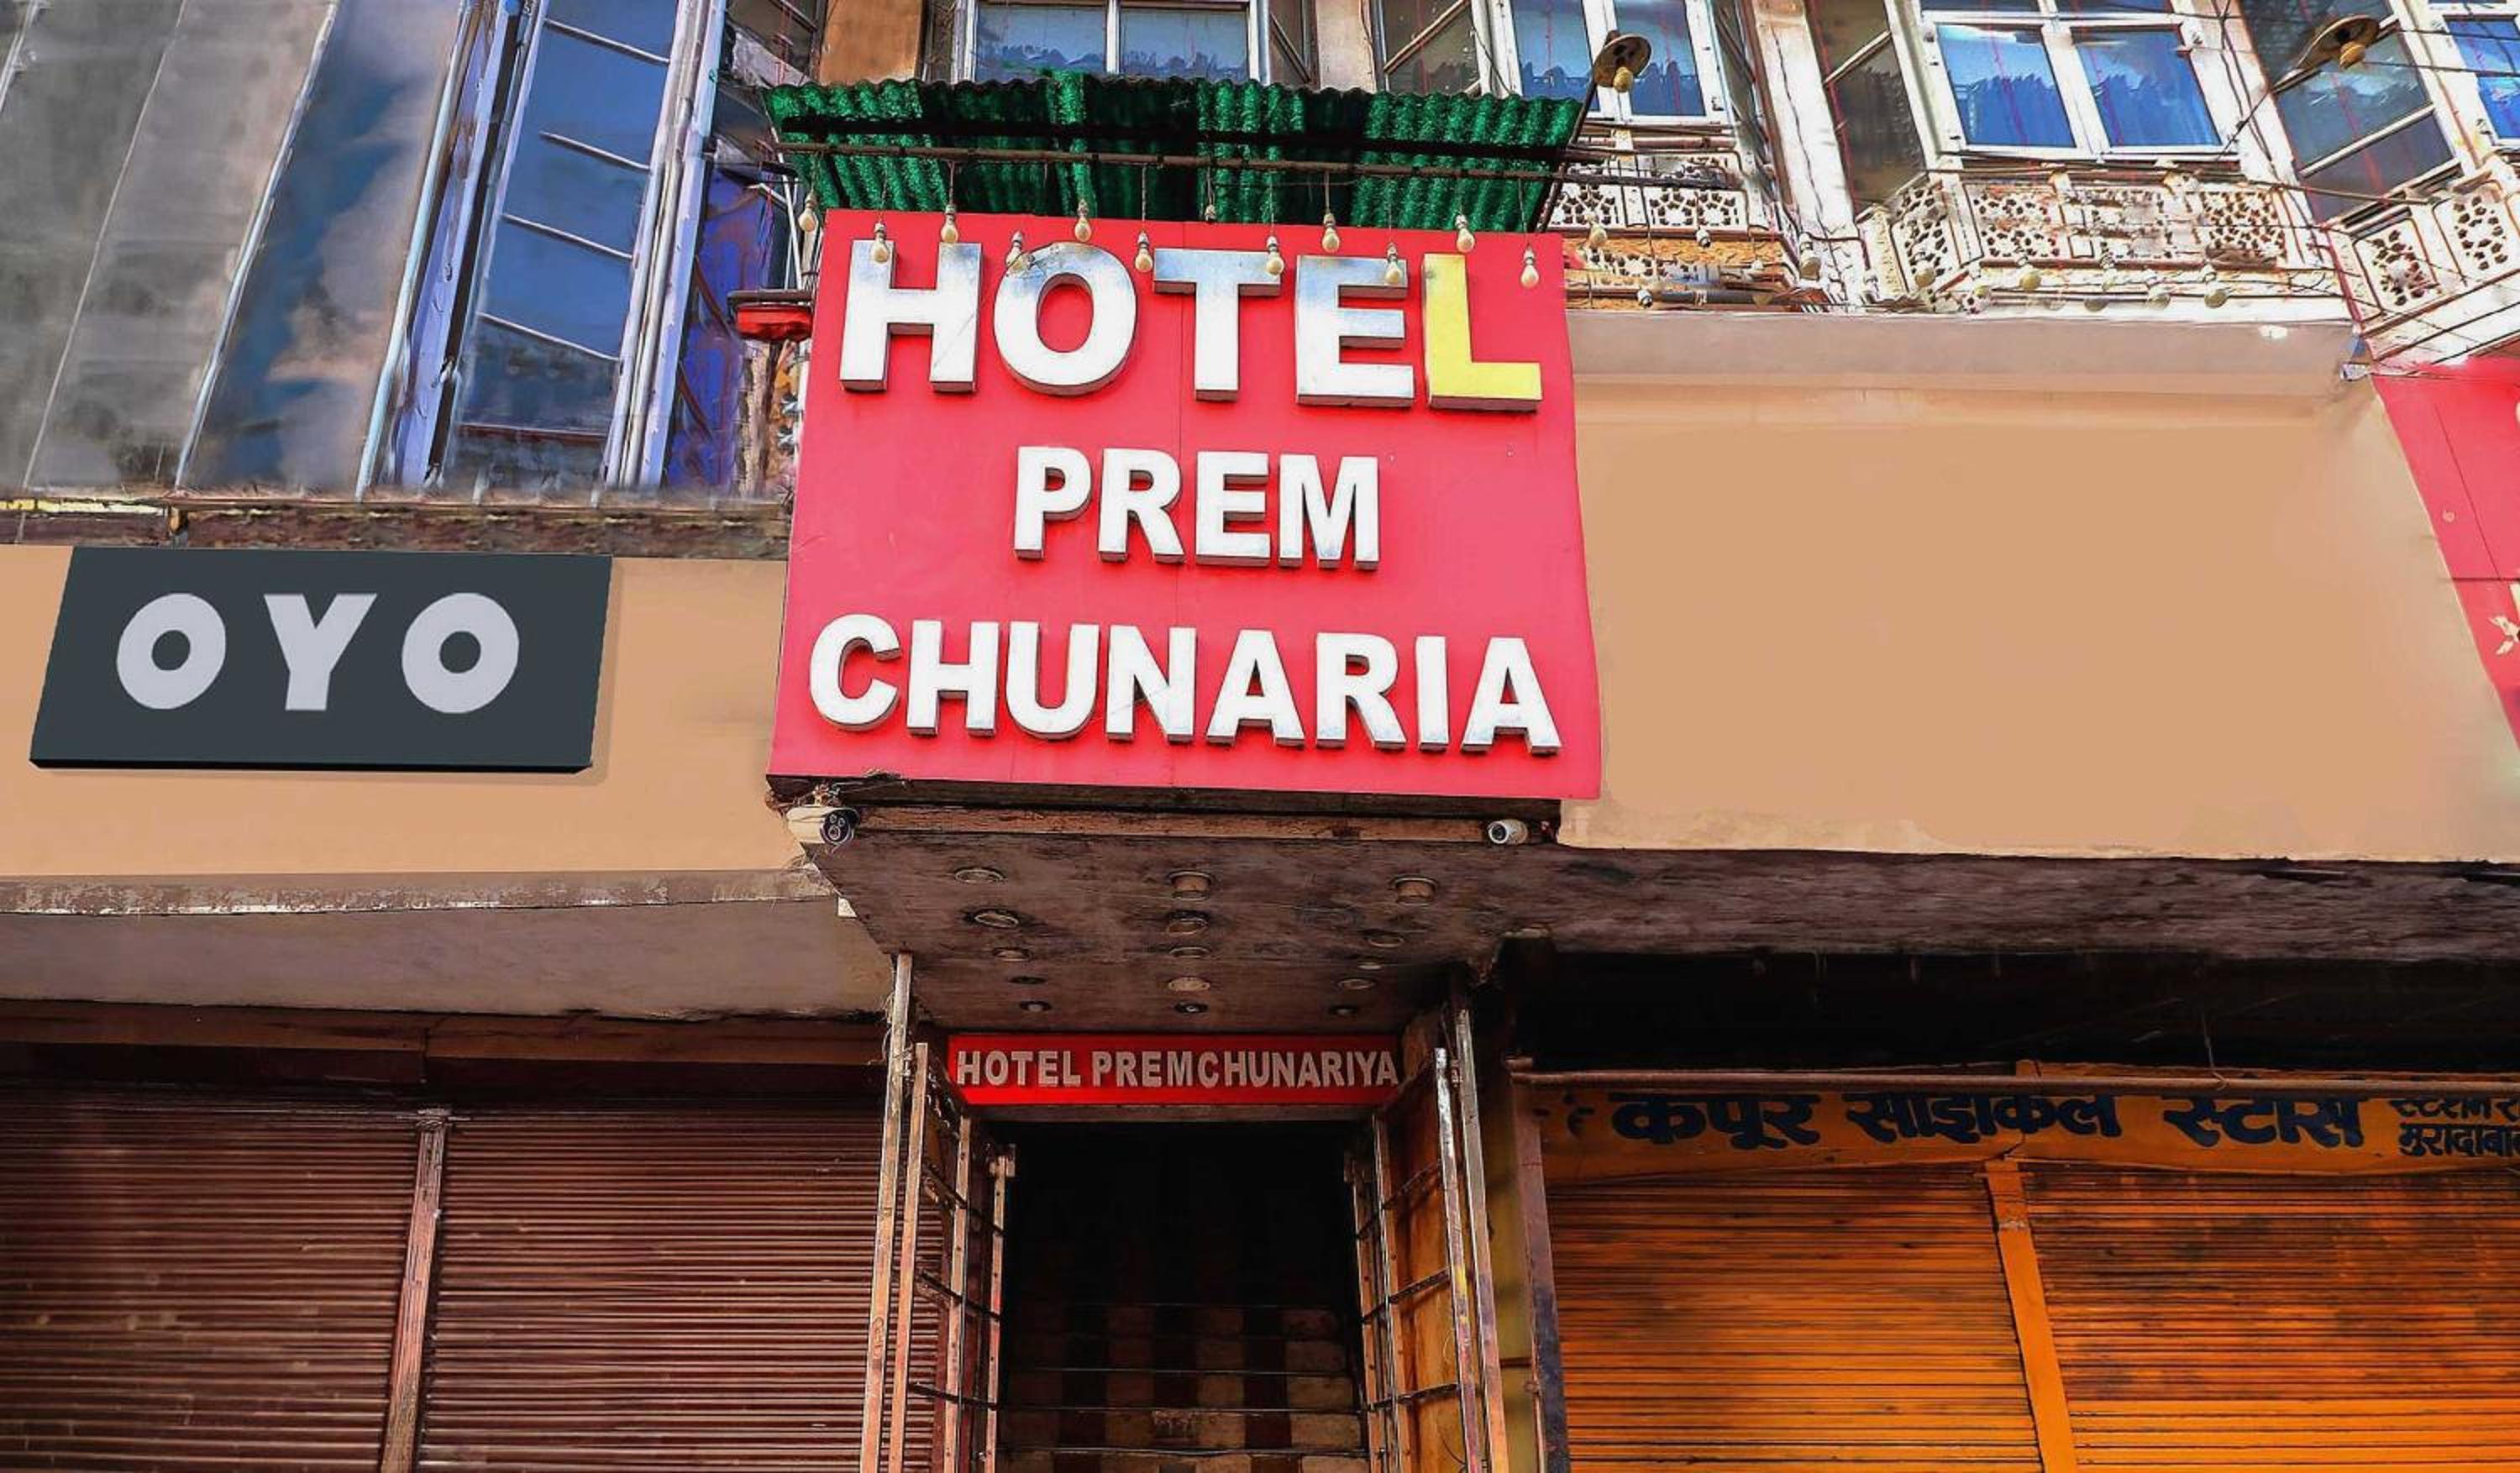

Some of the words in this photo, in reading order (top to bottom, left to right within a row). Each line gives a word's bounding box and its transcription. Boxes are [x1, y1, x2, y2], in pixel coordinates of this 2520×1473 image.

[840, 241, 1543, 412] HOTEL
[1013, 446, 1379, 571] PREM
[116, 592, 521, 714] OYO
[808, 614, 1562, 756] CHUNARIA
[956, 1050, 1082, 1088] HOTEL
[1091, 1050, 1399, 1089] PREMCHUNARIYA
[1608, 1092, 1821, 1150] कपूर
